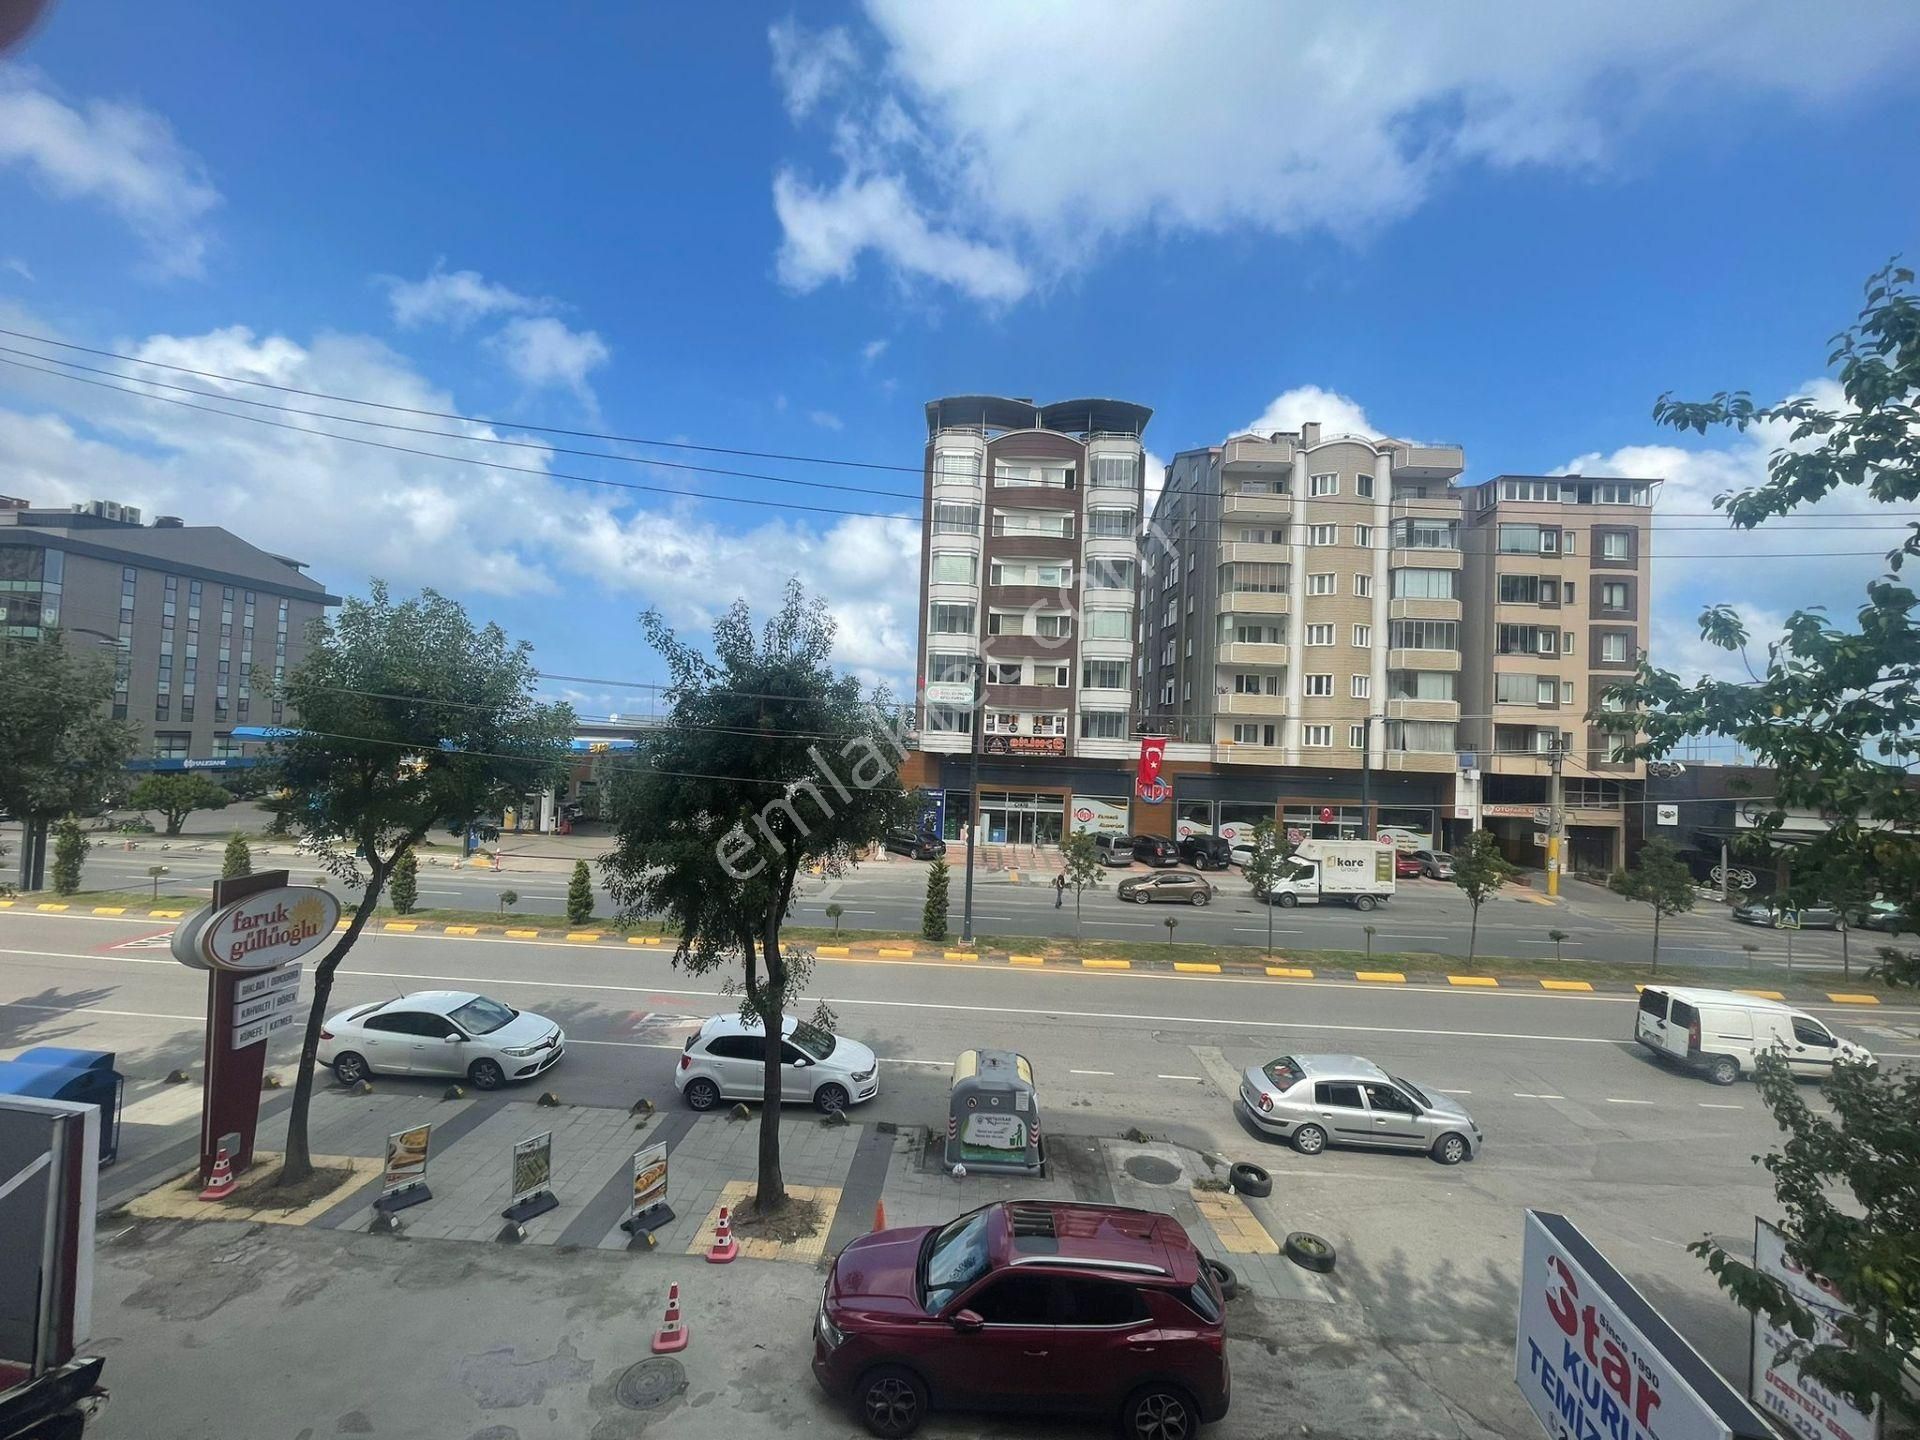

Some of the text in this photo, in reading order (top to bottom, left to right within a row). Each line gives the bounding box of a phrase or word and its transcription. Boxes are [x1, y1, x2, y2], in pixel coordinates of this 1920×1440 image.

[1337, 857, 1364, 867] kare
[232, 902, 289, 933] faruk
[230, 919, 319, 961] güllüoğlu
[1545, 1255, 1661, 1430] Star
[1599, 1313, 1660, 1389] Since 1990
